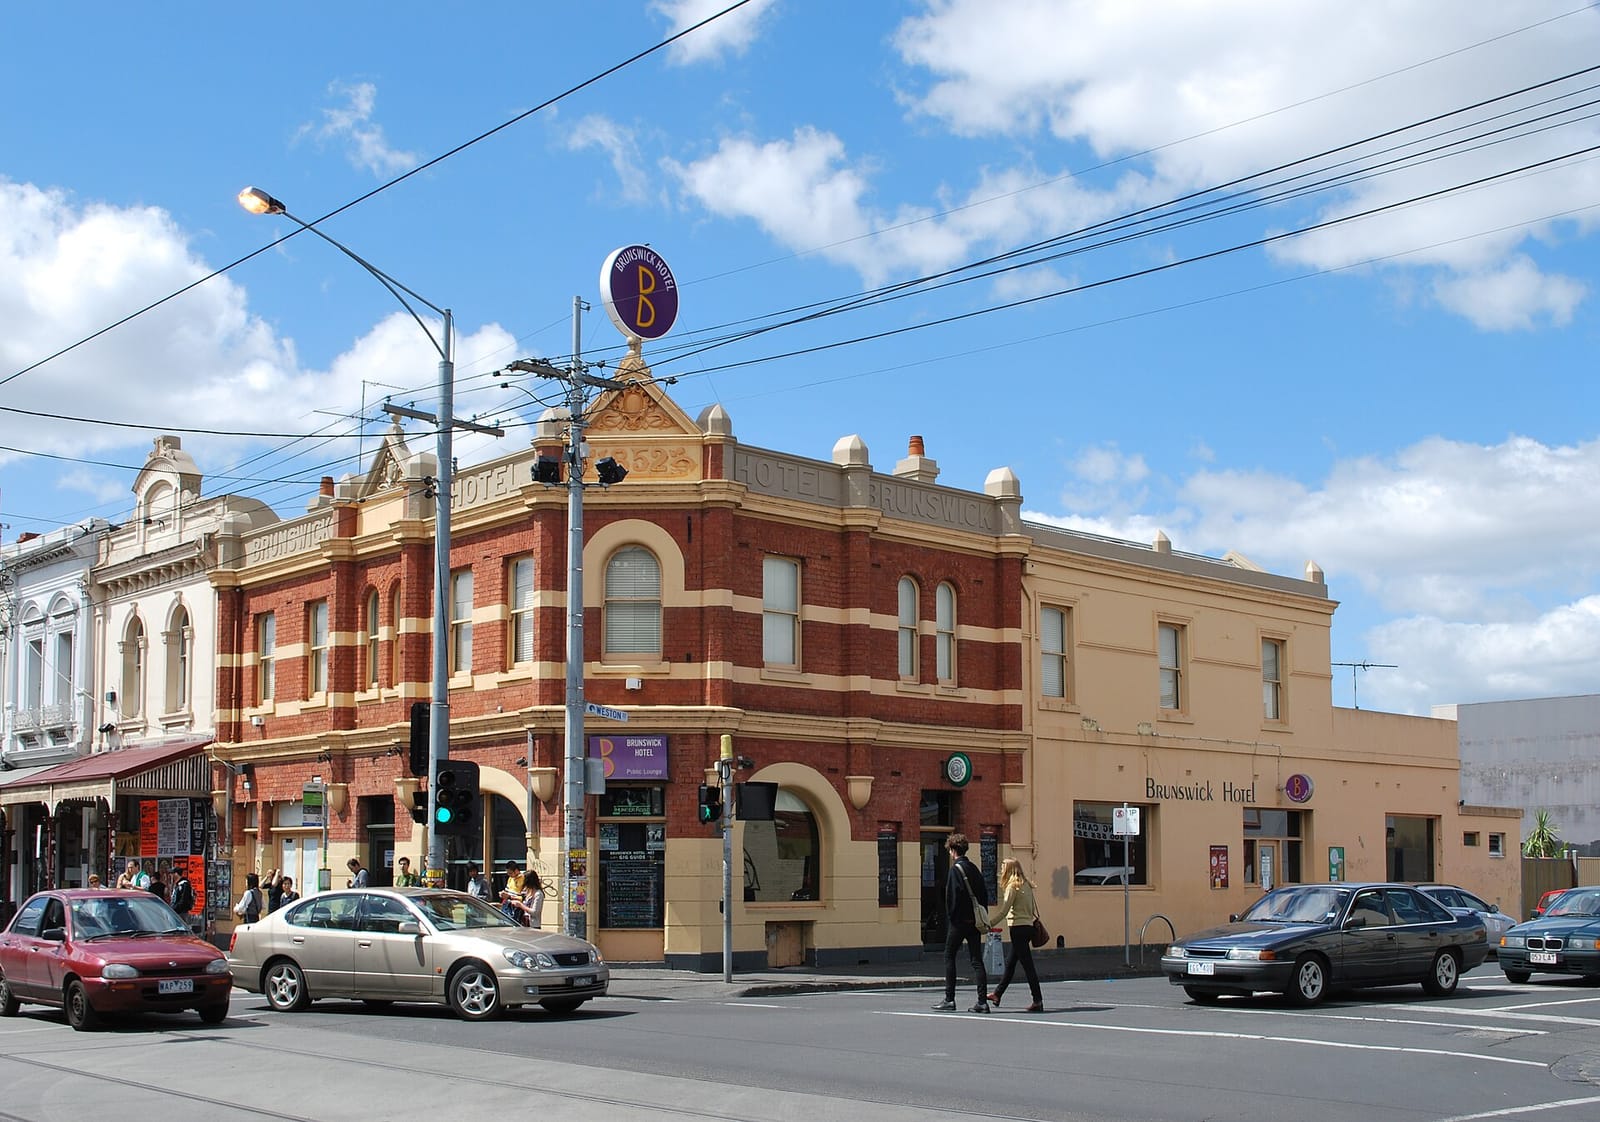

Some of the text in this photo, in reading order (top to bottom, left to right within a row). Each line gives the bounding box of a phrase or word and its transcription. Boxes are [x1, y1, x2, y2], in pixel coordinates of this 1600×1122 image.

[615, 248, 674, 292] BRUNSWICK HOTEL
[636, 264, 656, 328] B
[451, 463, 519, 509] HOTEL
[736, 453, 837, 501] HOTEL
[868, 483, 992, 530] BRUNSWICK
[252, 516, 333, 562] BRUNSWICK
[595, 706, 622, 719] WESTON
[626, 738, 662, 747] BRUNSWICK
[634, 748, 654, 757] HOTEL
[643, 768, 662, 776] Lounge
